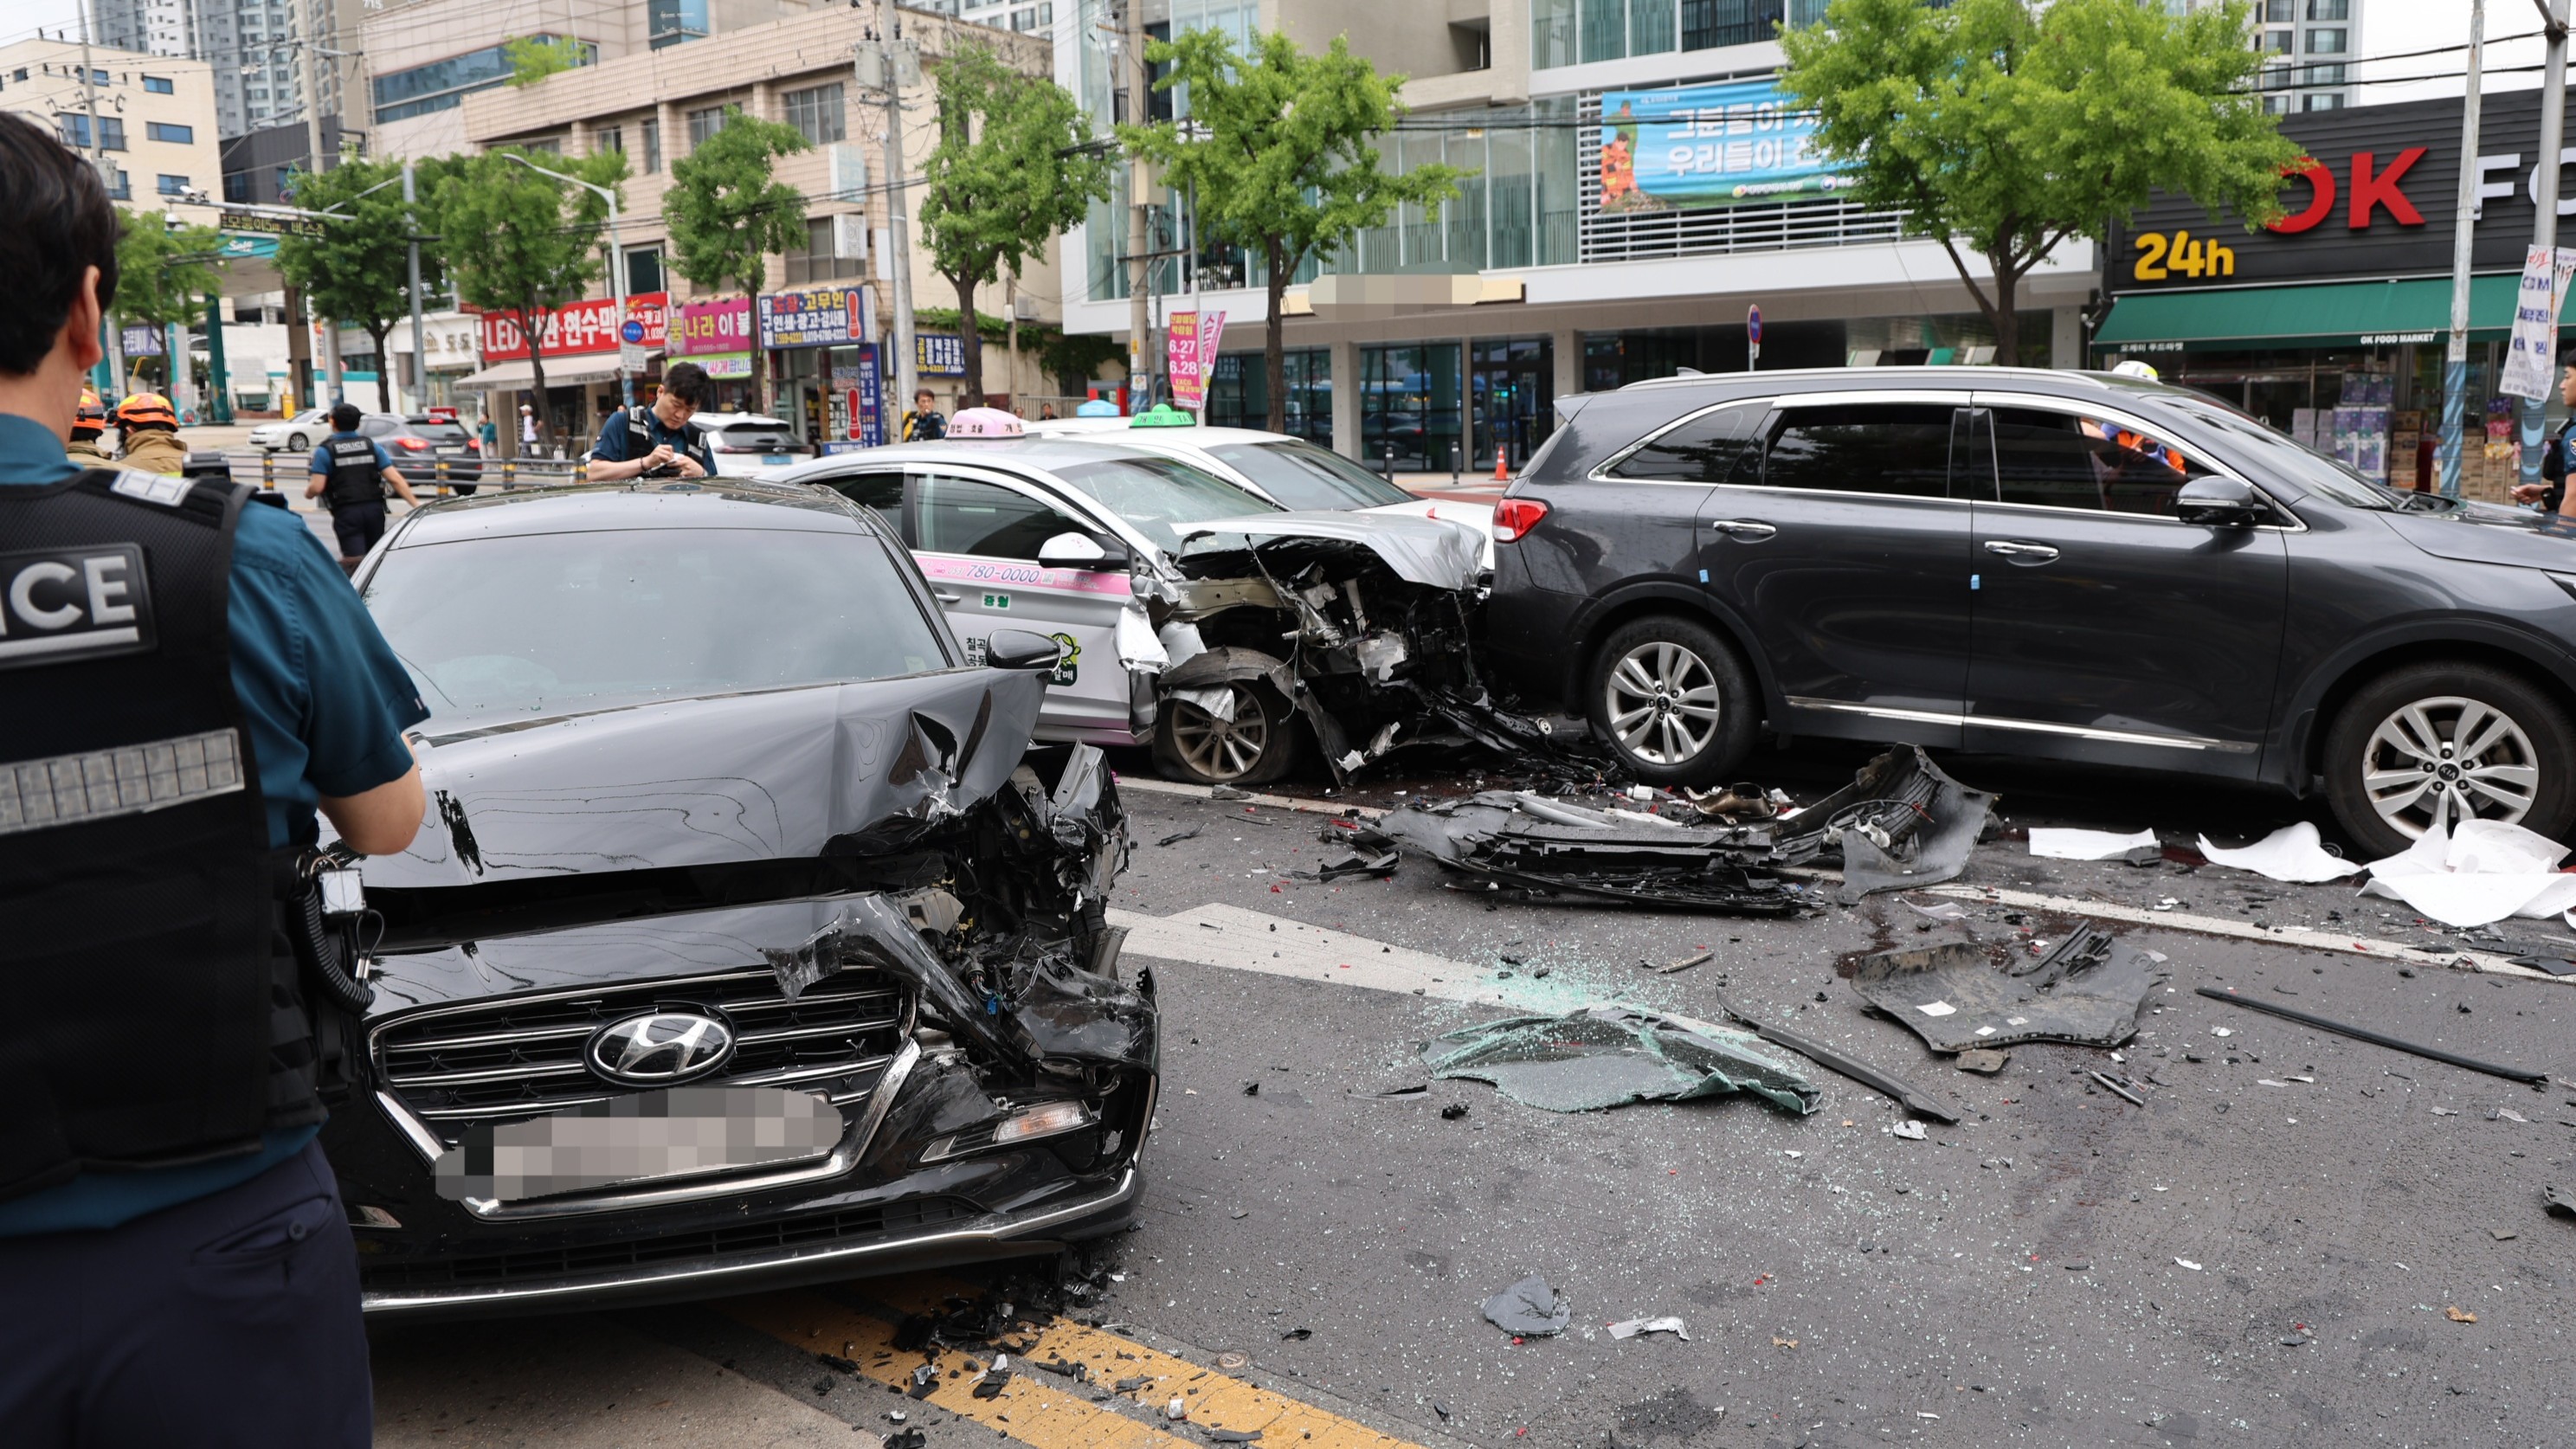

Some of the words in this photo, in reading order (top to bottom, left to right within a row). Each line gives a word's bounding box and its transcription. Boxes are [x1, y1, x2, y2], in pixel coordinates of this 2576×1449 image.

[1667, 100, 1784, 139] 그분들이
[1667, 139, 1785, 177] 우리들이
[2264, 147, 2427, 234] OK
[2134, 230, 2234, 281] 24h
[718, 311, 750, 337] 이불
[485, 317, 519, 353] LED
[2360, 335, 2373, 345] OK
[2374, 334, 2399, 345] FOOD
[2399, 332, 2435, 344] MARKET
[1169, 339, 1196, 355] 6.27
[1169, 360, 1198, 376] 6.28
[970, 424, 983, 434] 호출
[335, 441, 366, 450] POLICE
[966, 564, 1040, 583] 780-0000
[2440, 765, 2457, 780] KIA
